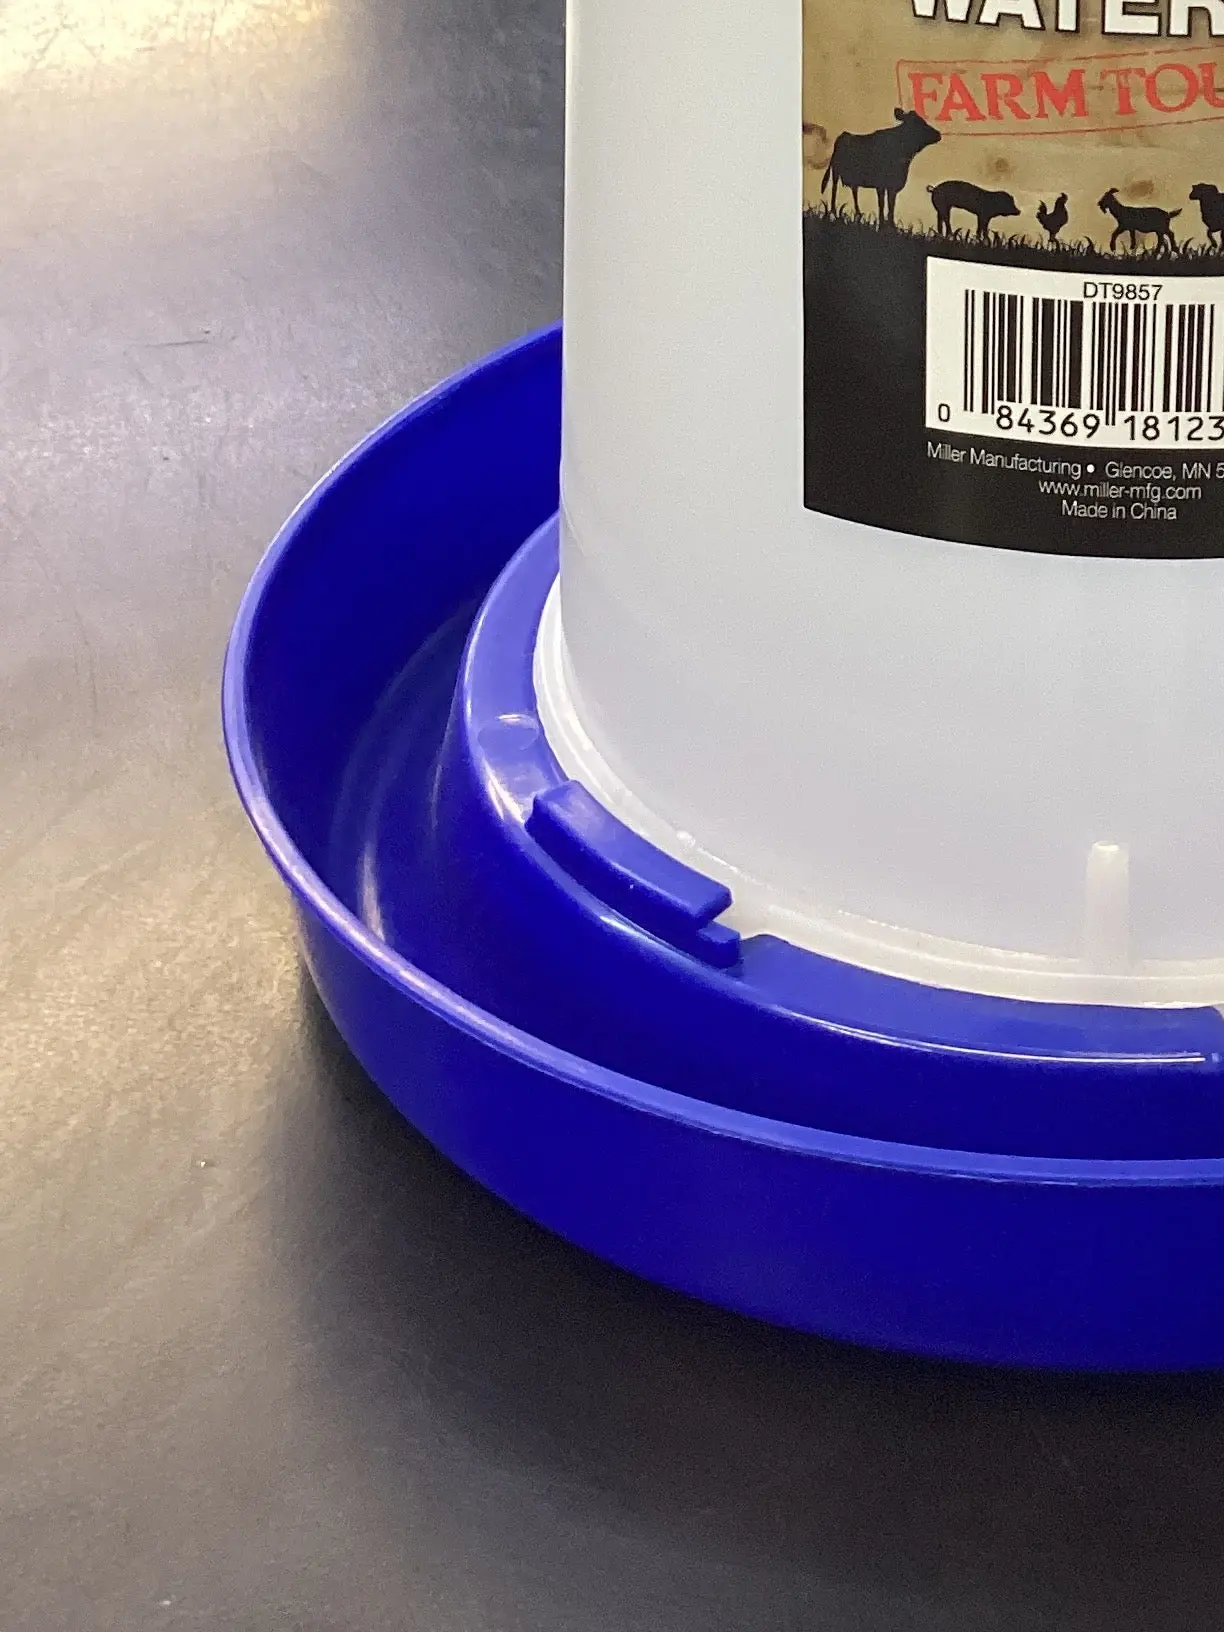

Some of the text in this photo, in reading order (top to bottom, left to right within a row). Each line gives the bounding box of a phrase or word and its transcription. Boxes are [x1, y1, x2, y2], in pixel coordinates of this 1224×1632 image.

[908, 68, 1089, 123] FARM
[1082, 281, 1163, 301] DT9857
[938, 403, 951, 422] 0
[996, 405, 1101, 439] 84369
[926, 441, 967, 463] Miller
[970, 447, 1082, 480] Manufacturing
[1105, 461, 1177, 481] Glencoe,
[1182, 462, 1212, 480] MN
[1038, 479, 1202, 503] www.miller-mfg.com
[1061, 499, 1177, 520] Made in China
